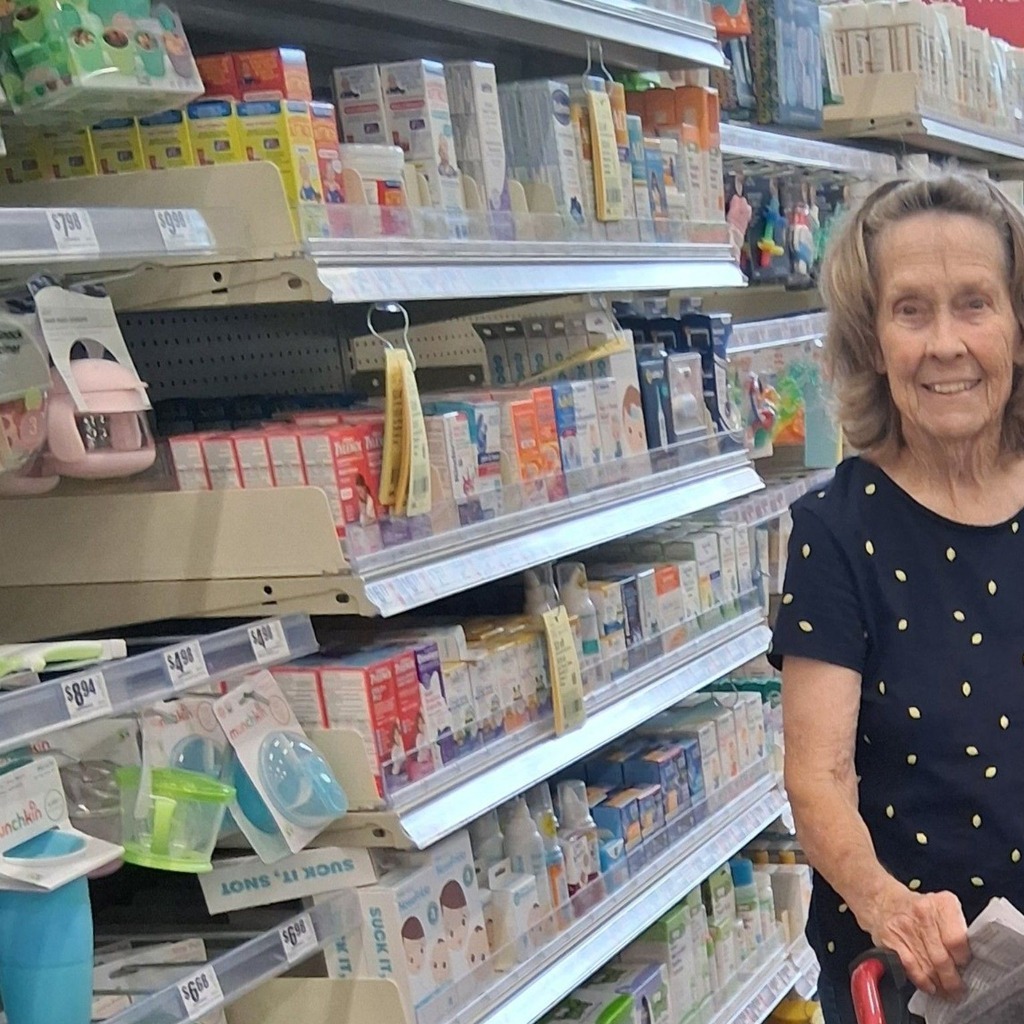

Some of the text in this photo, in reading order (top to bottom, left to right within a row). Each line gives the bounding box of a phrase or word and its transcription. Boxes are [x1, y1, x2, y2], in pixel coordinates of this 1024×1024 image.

[51, 211, 83, 238] $798
[159, 210, 188, 236] $998
[167, 647, 195, 676] $498
[65, 678, 97, 708] $894
[0, 800, 43, 838] unchkin
[304, 857, 355, 882] SUCK
[220, 873, 271, 898] SNOT
[282, 919, 308, 947] $698
[369, 906, 389, 954] SUCK
